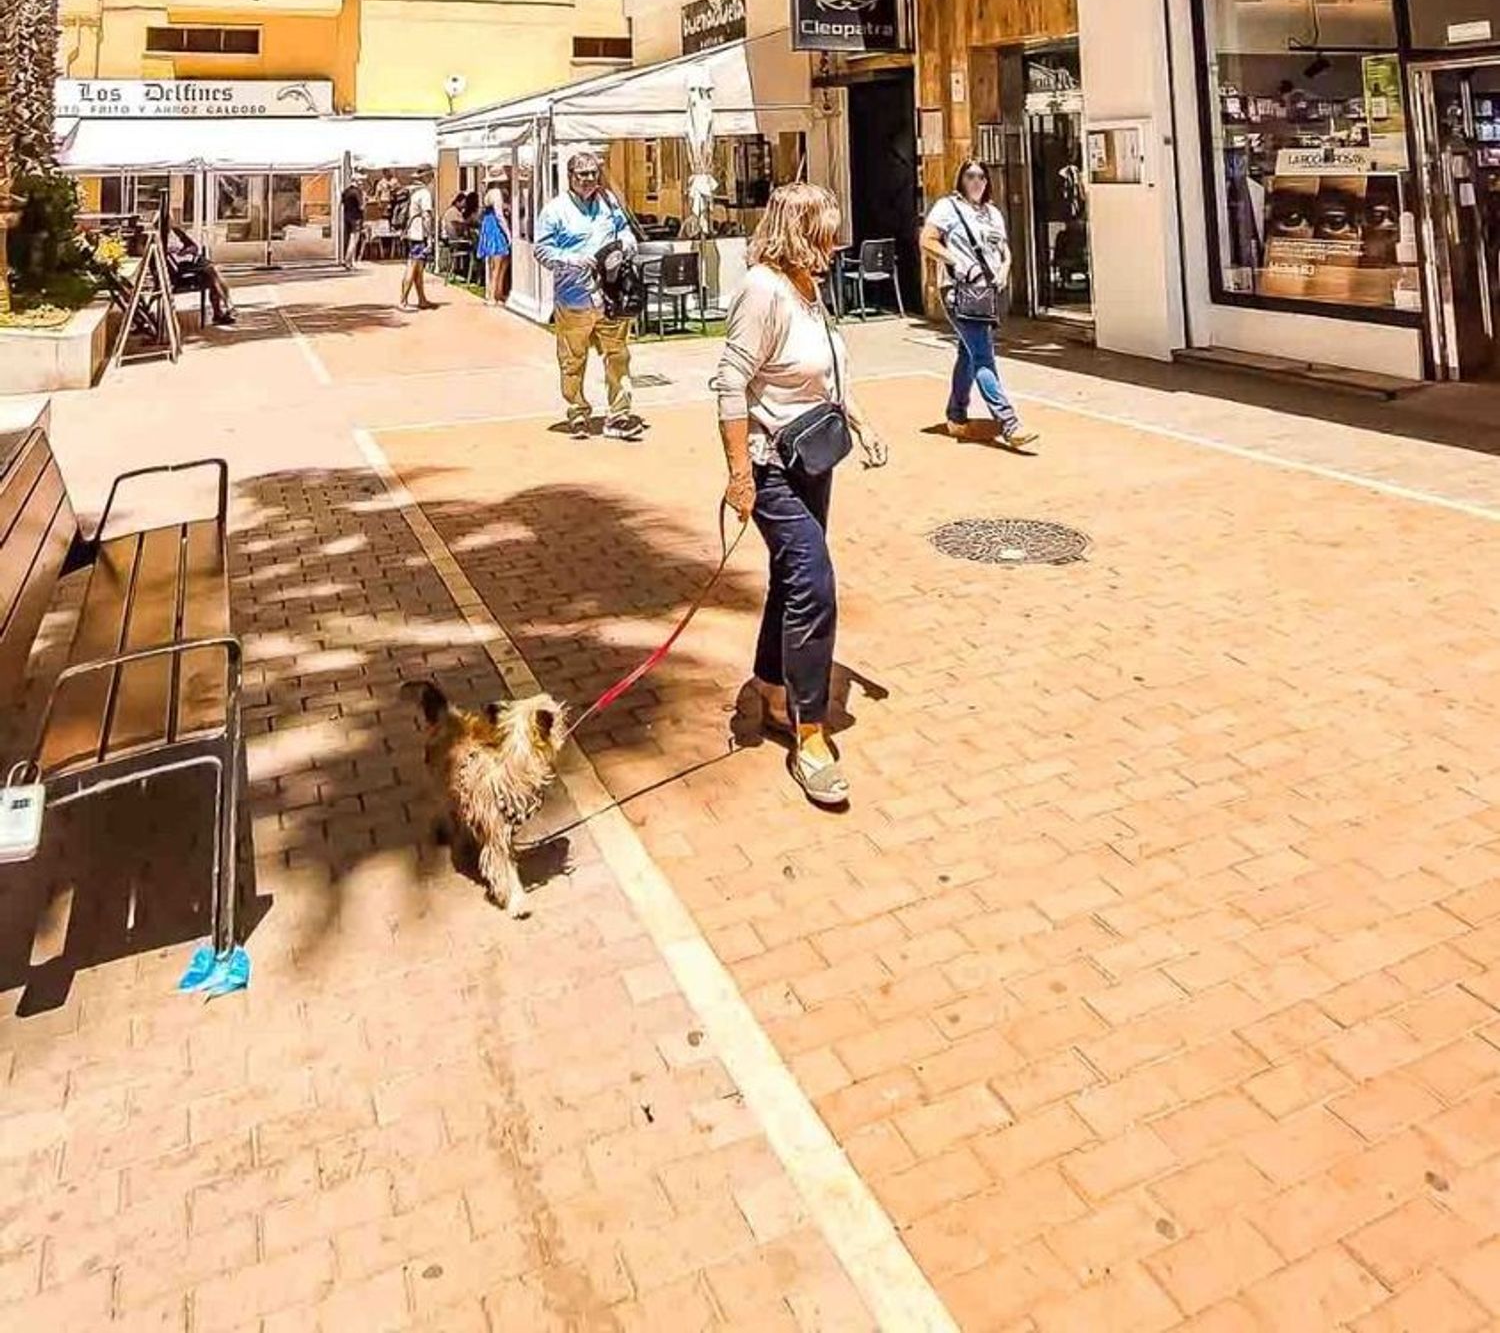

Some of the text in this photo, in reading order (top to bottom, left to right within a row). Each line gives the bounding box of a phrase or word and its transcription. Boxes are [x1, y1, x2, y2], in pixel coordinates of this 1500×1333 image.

[801, 19, 894, 38] Cleopatra
[77, 82, 233, 102] Los Delfines
[90, 105, 130, 114] FRITO
[138, 105, 146, 114] Y
[154, 105, 198, 114] ARROZ
[206, 105, 267, 115] CALDOSO
